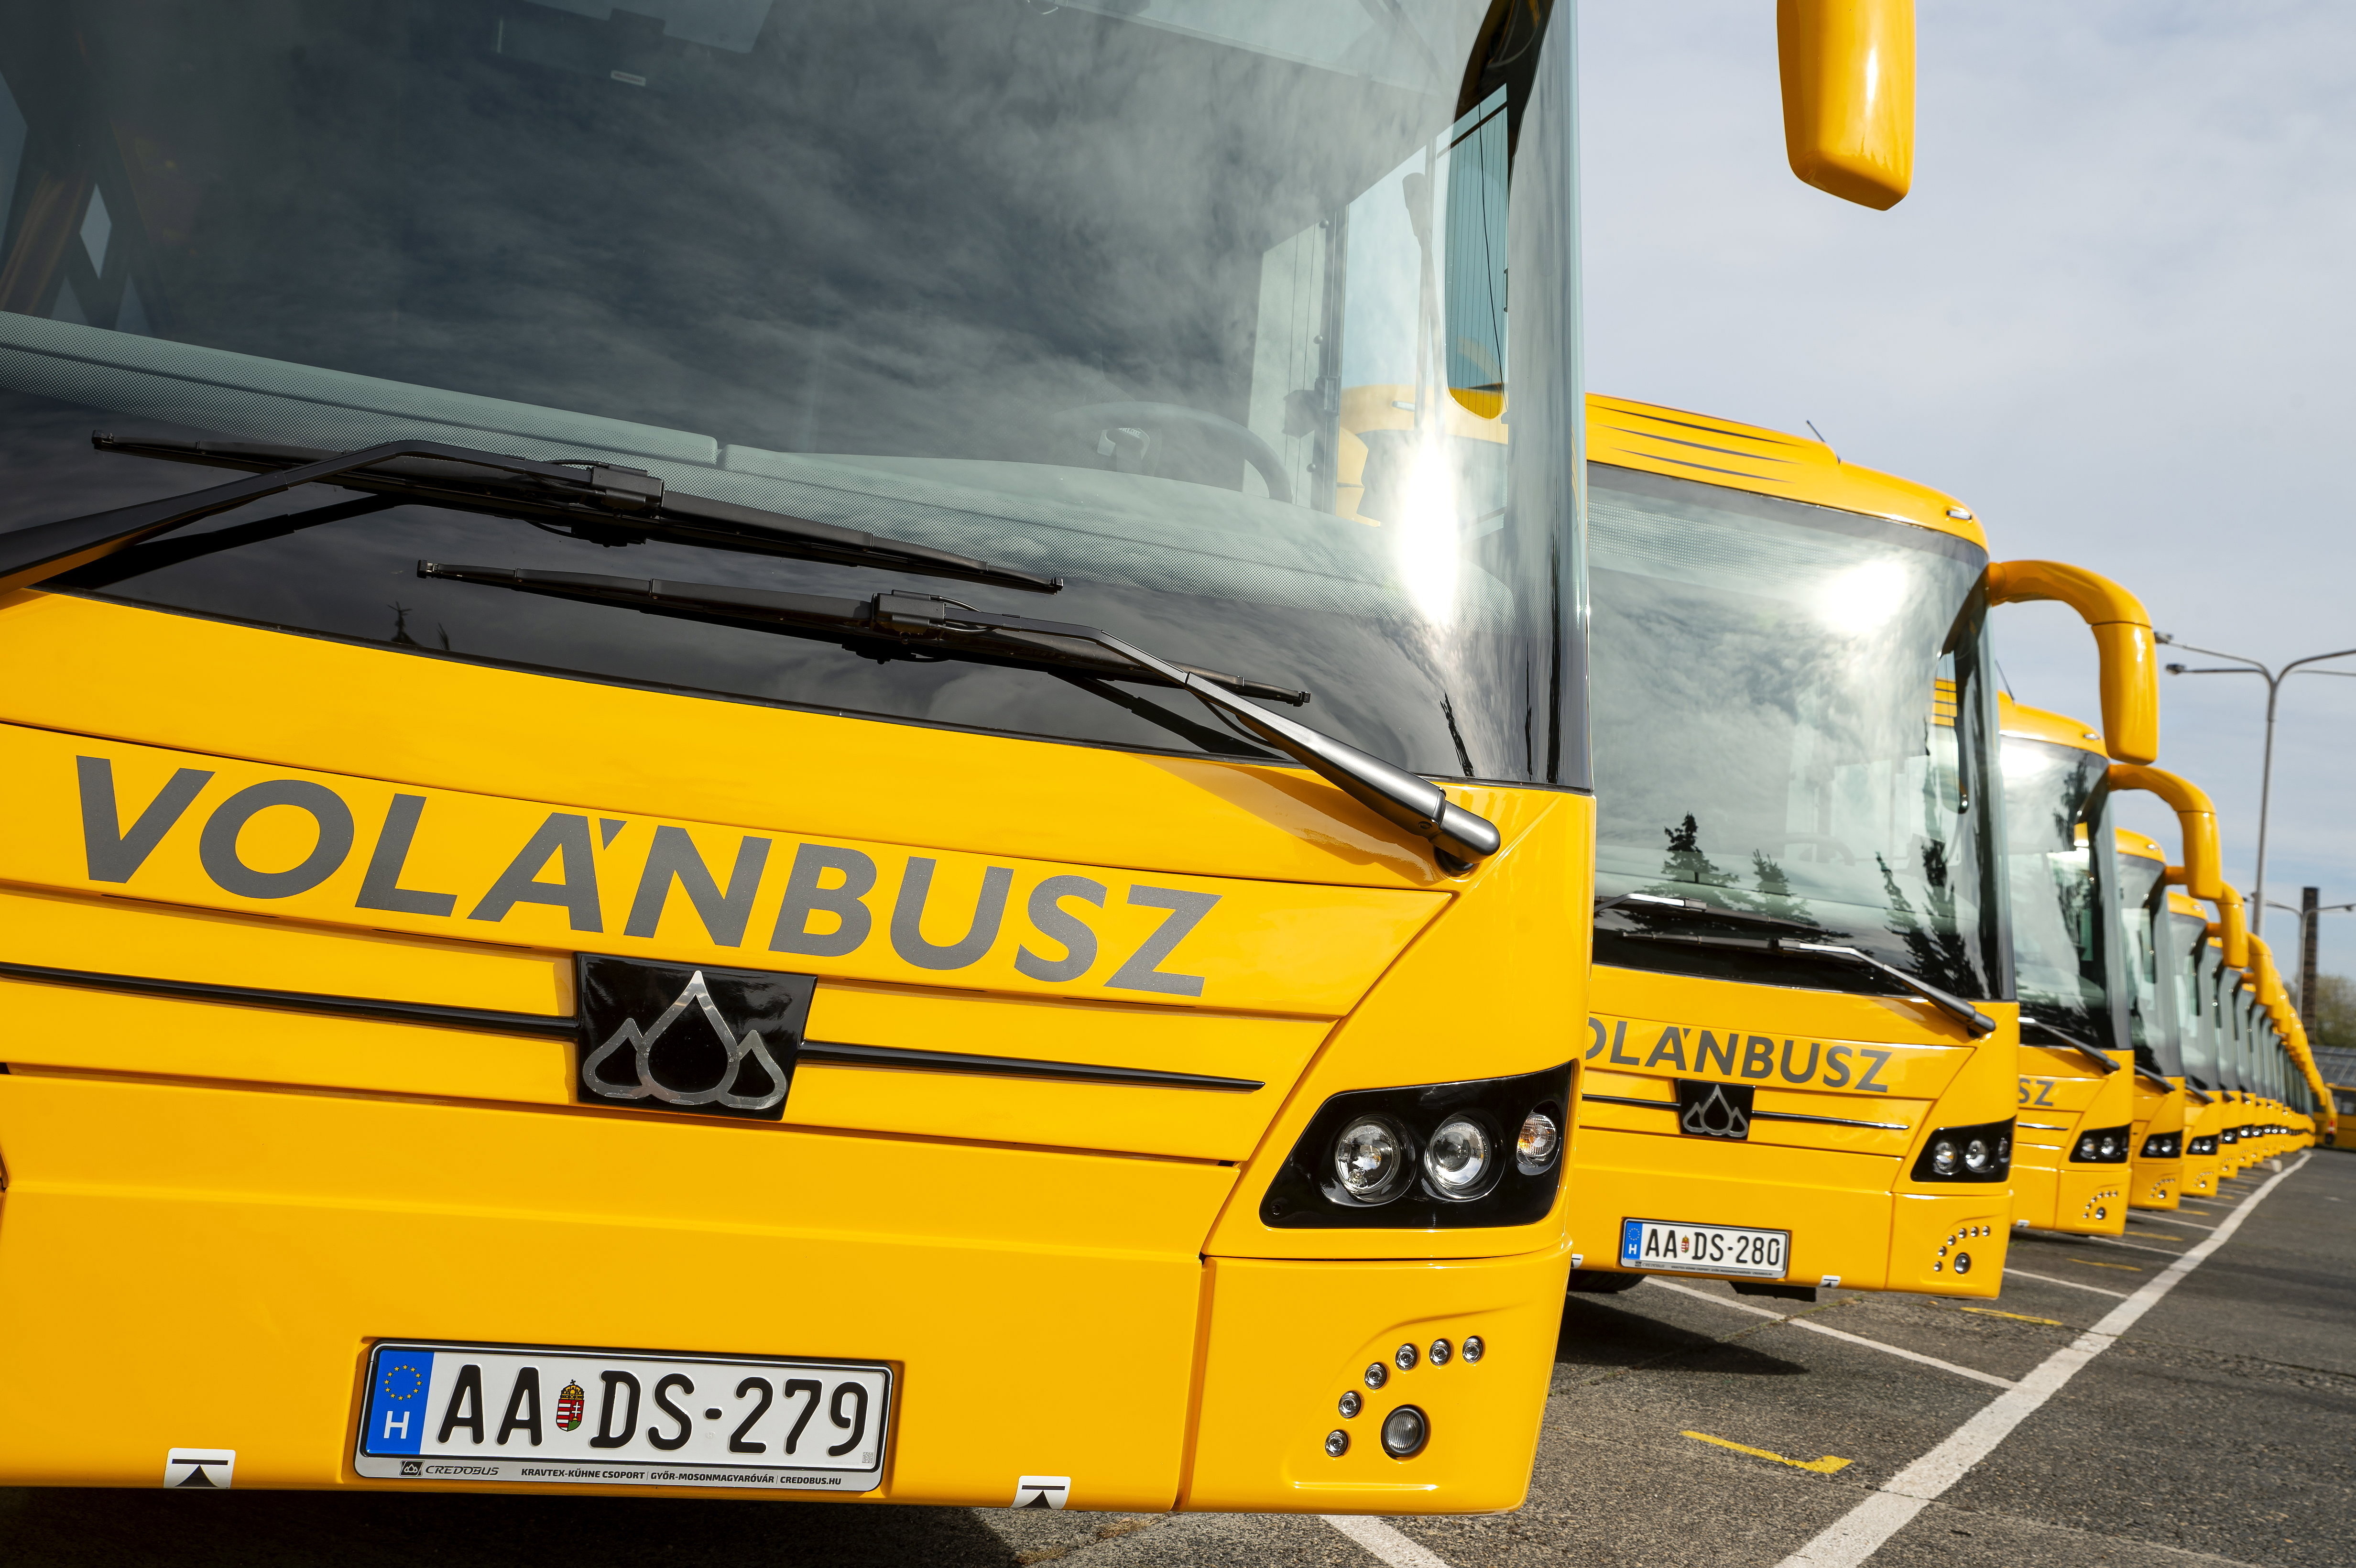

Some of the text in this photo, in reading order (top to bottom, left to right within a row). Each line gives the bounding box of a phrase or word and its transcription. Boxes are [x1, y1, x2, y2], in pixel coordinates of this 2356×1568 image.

[76, 755, 1223, 997] VOLÁNBUSZ
[1628, 1243, 1637, 1255] H
[1645, 1228, 1780, 1266] AA DS-280
[383, 1410, 410, 1439] H
[437, 1364, 869, 1457] AA DS-279
[425, 1465, 500, 1476] CREDOBUS
[521, 1468, 842, 1485] KRAVTEX-KÜHNE CSOPORT GYŐR-MOSONMAGYARÓVÁR CREDOBUS.HU
